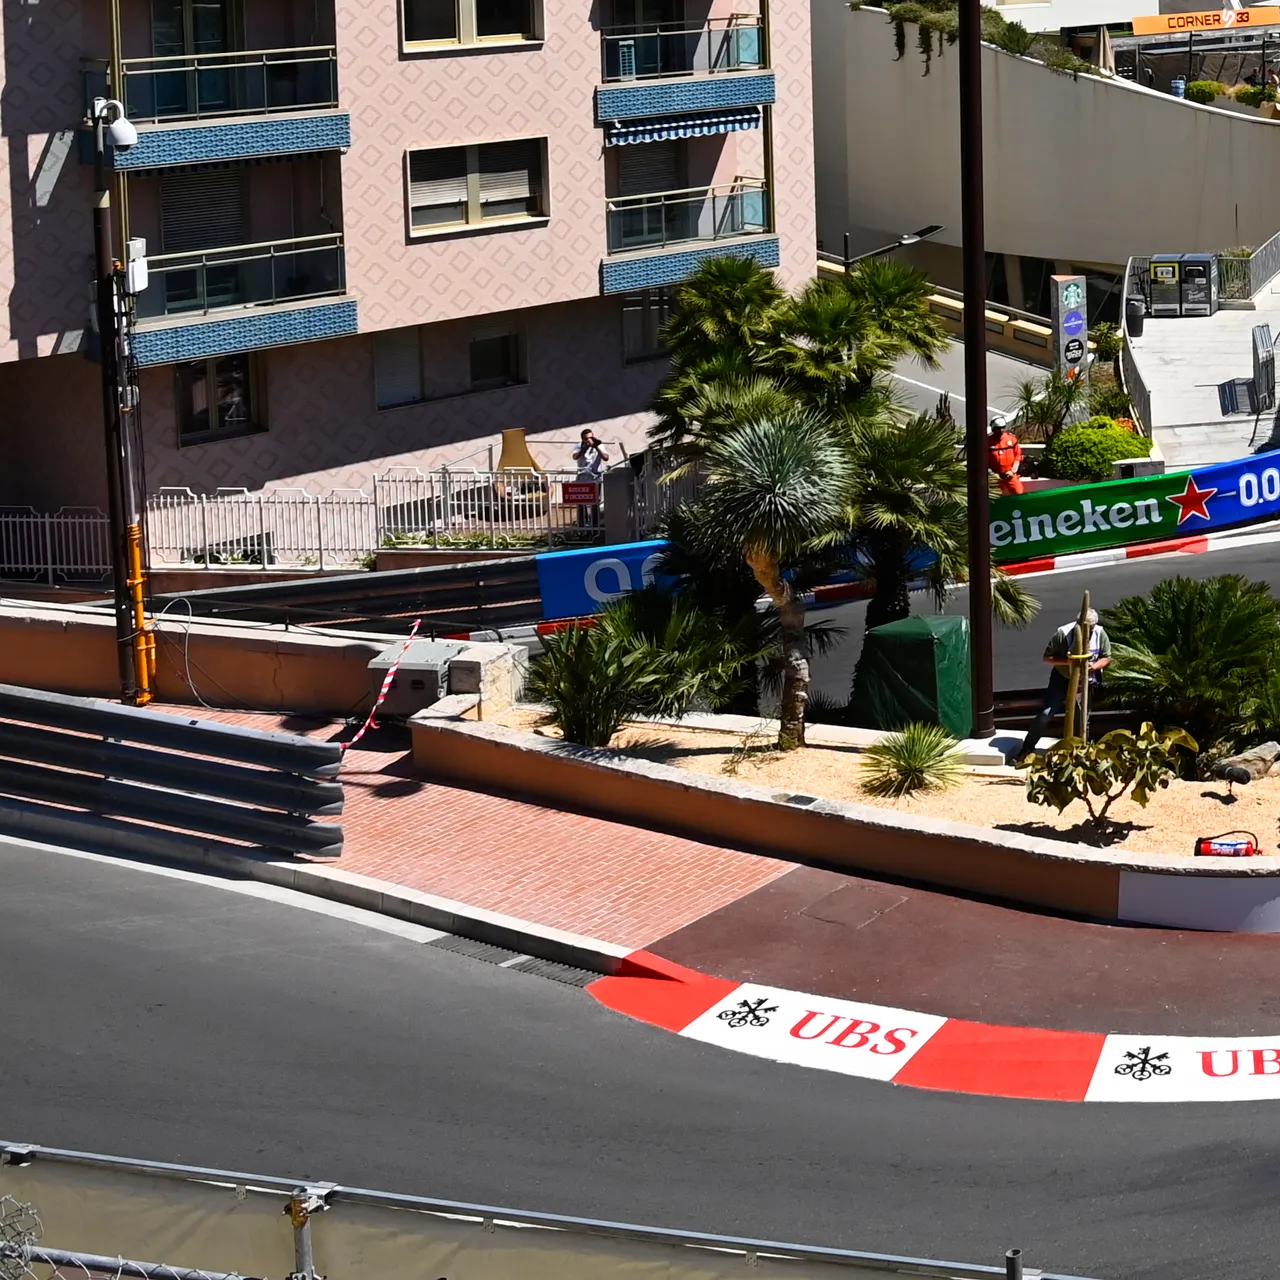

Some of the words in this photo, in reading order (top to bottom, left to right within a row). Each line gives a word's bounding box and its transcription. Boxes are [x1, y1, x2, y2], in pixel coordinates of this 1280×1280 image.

[1167, 14, 1221, 29] CORNER
[1236, 11, 1250, 23] 33
[1238, 467, 1280, 507] 0.0
[989, 495, 1162, 547] eineken
[789, 1009, 919, 1055] UBS
